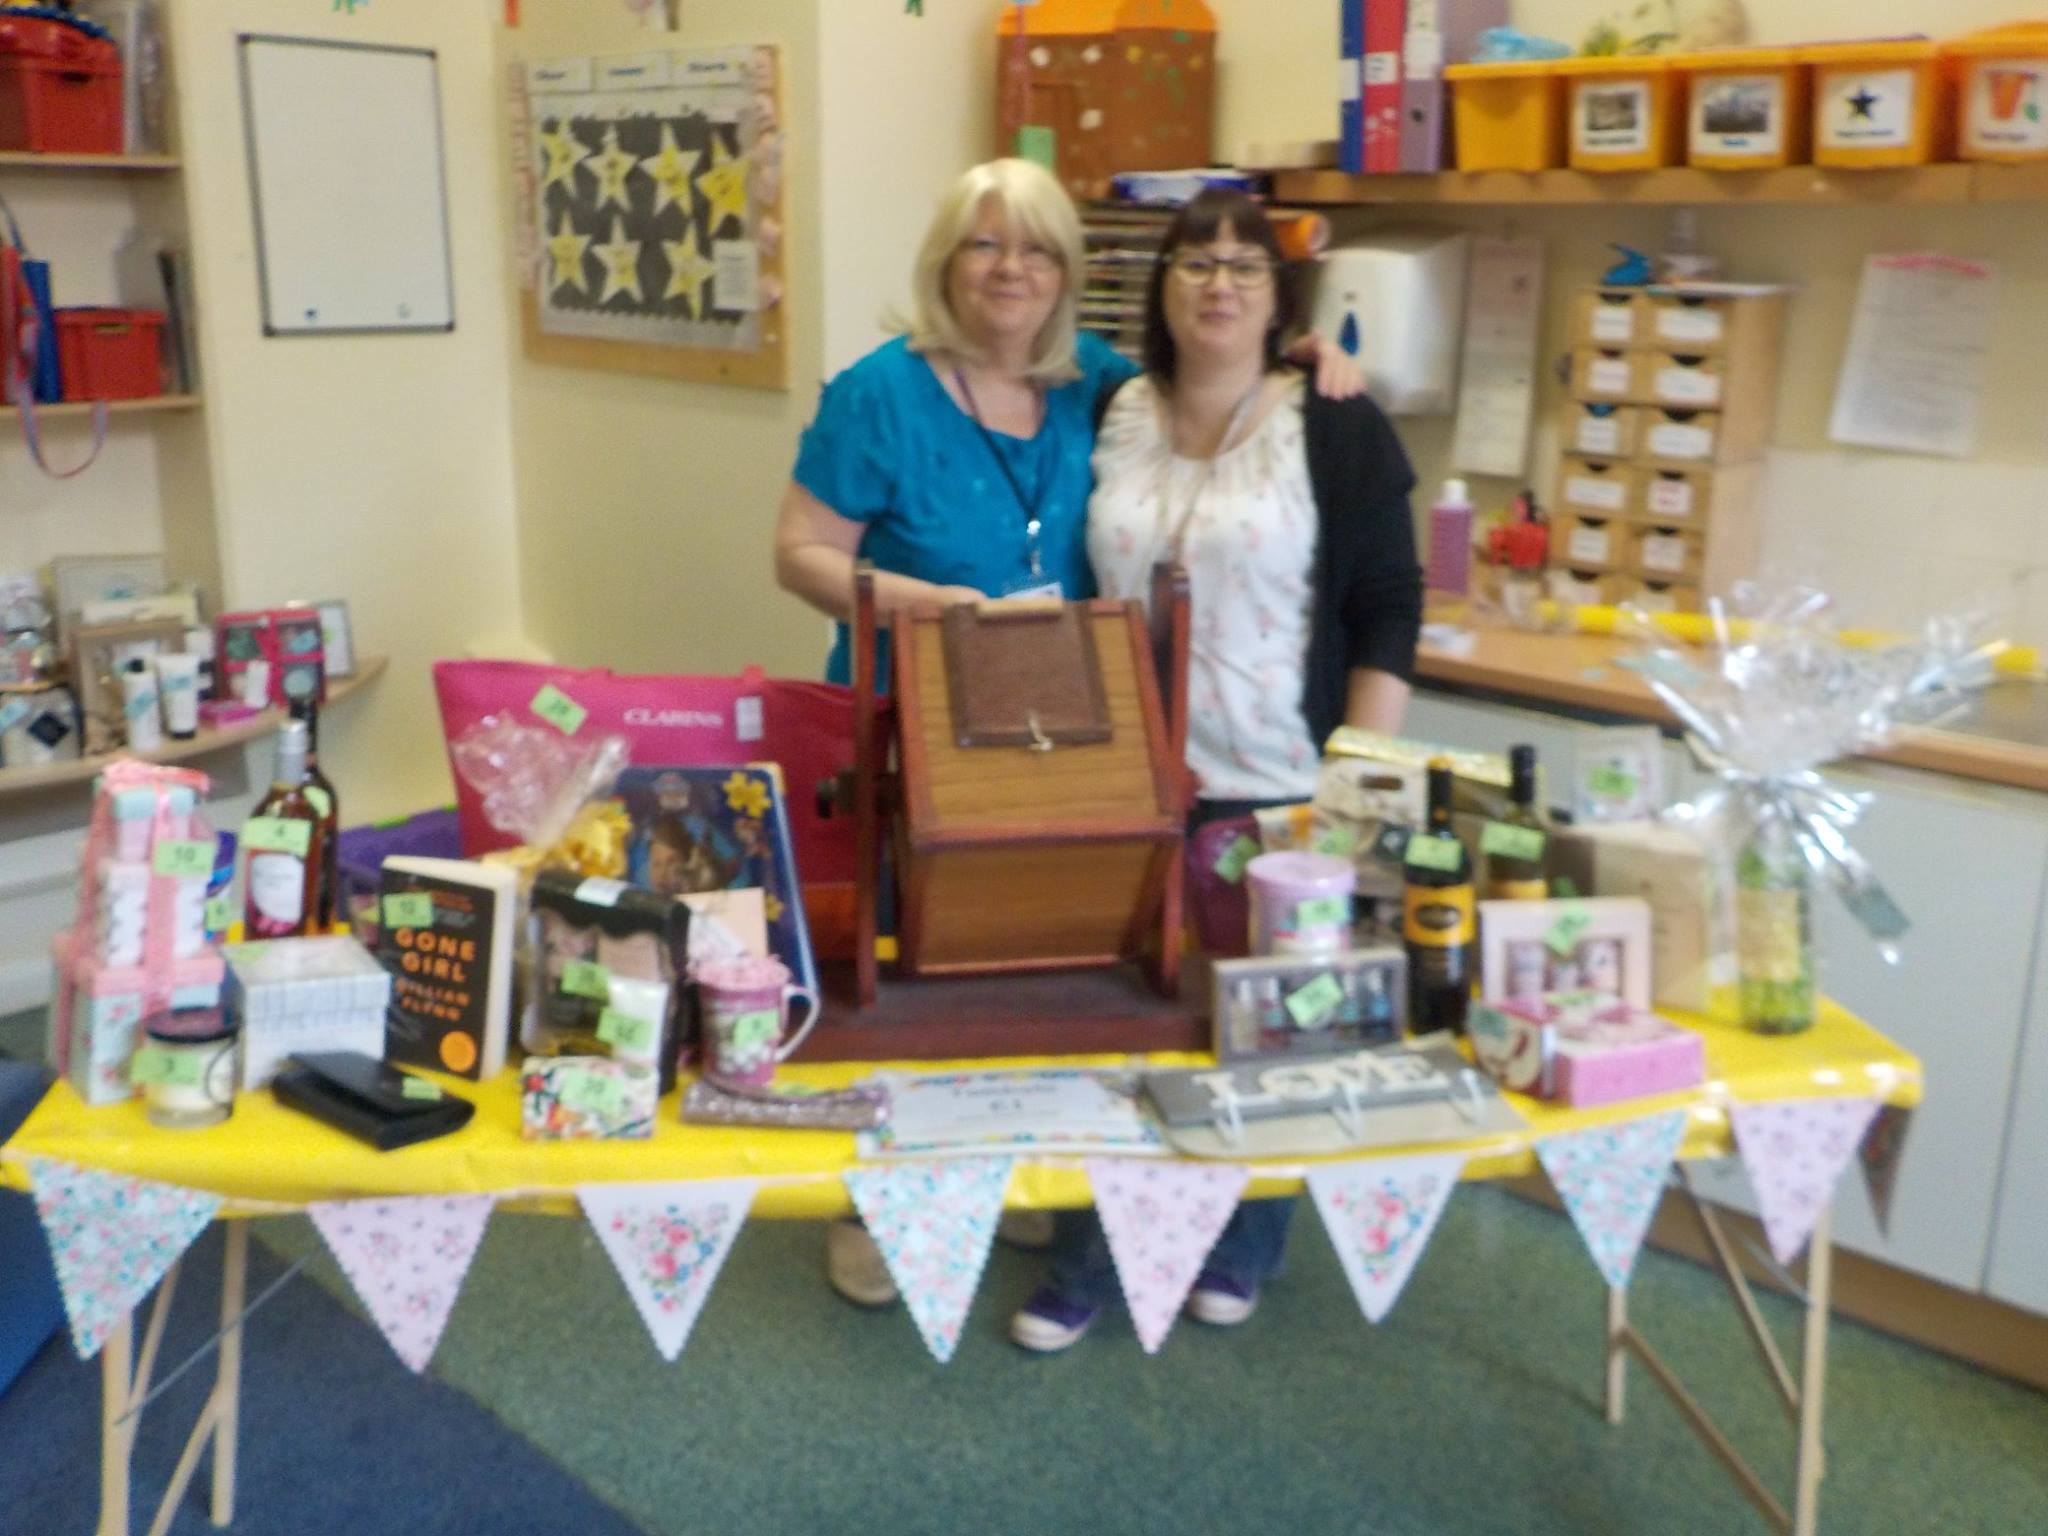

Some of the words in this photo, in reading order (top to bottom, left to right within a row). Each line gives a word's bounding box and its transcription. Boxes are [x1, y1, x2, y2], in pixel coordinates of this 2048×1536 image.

[396, 926, 476, 961] GONE
[402, 951, 466, 983] GIRL
[1190, 1050, 1451, 1109] LOVE
